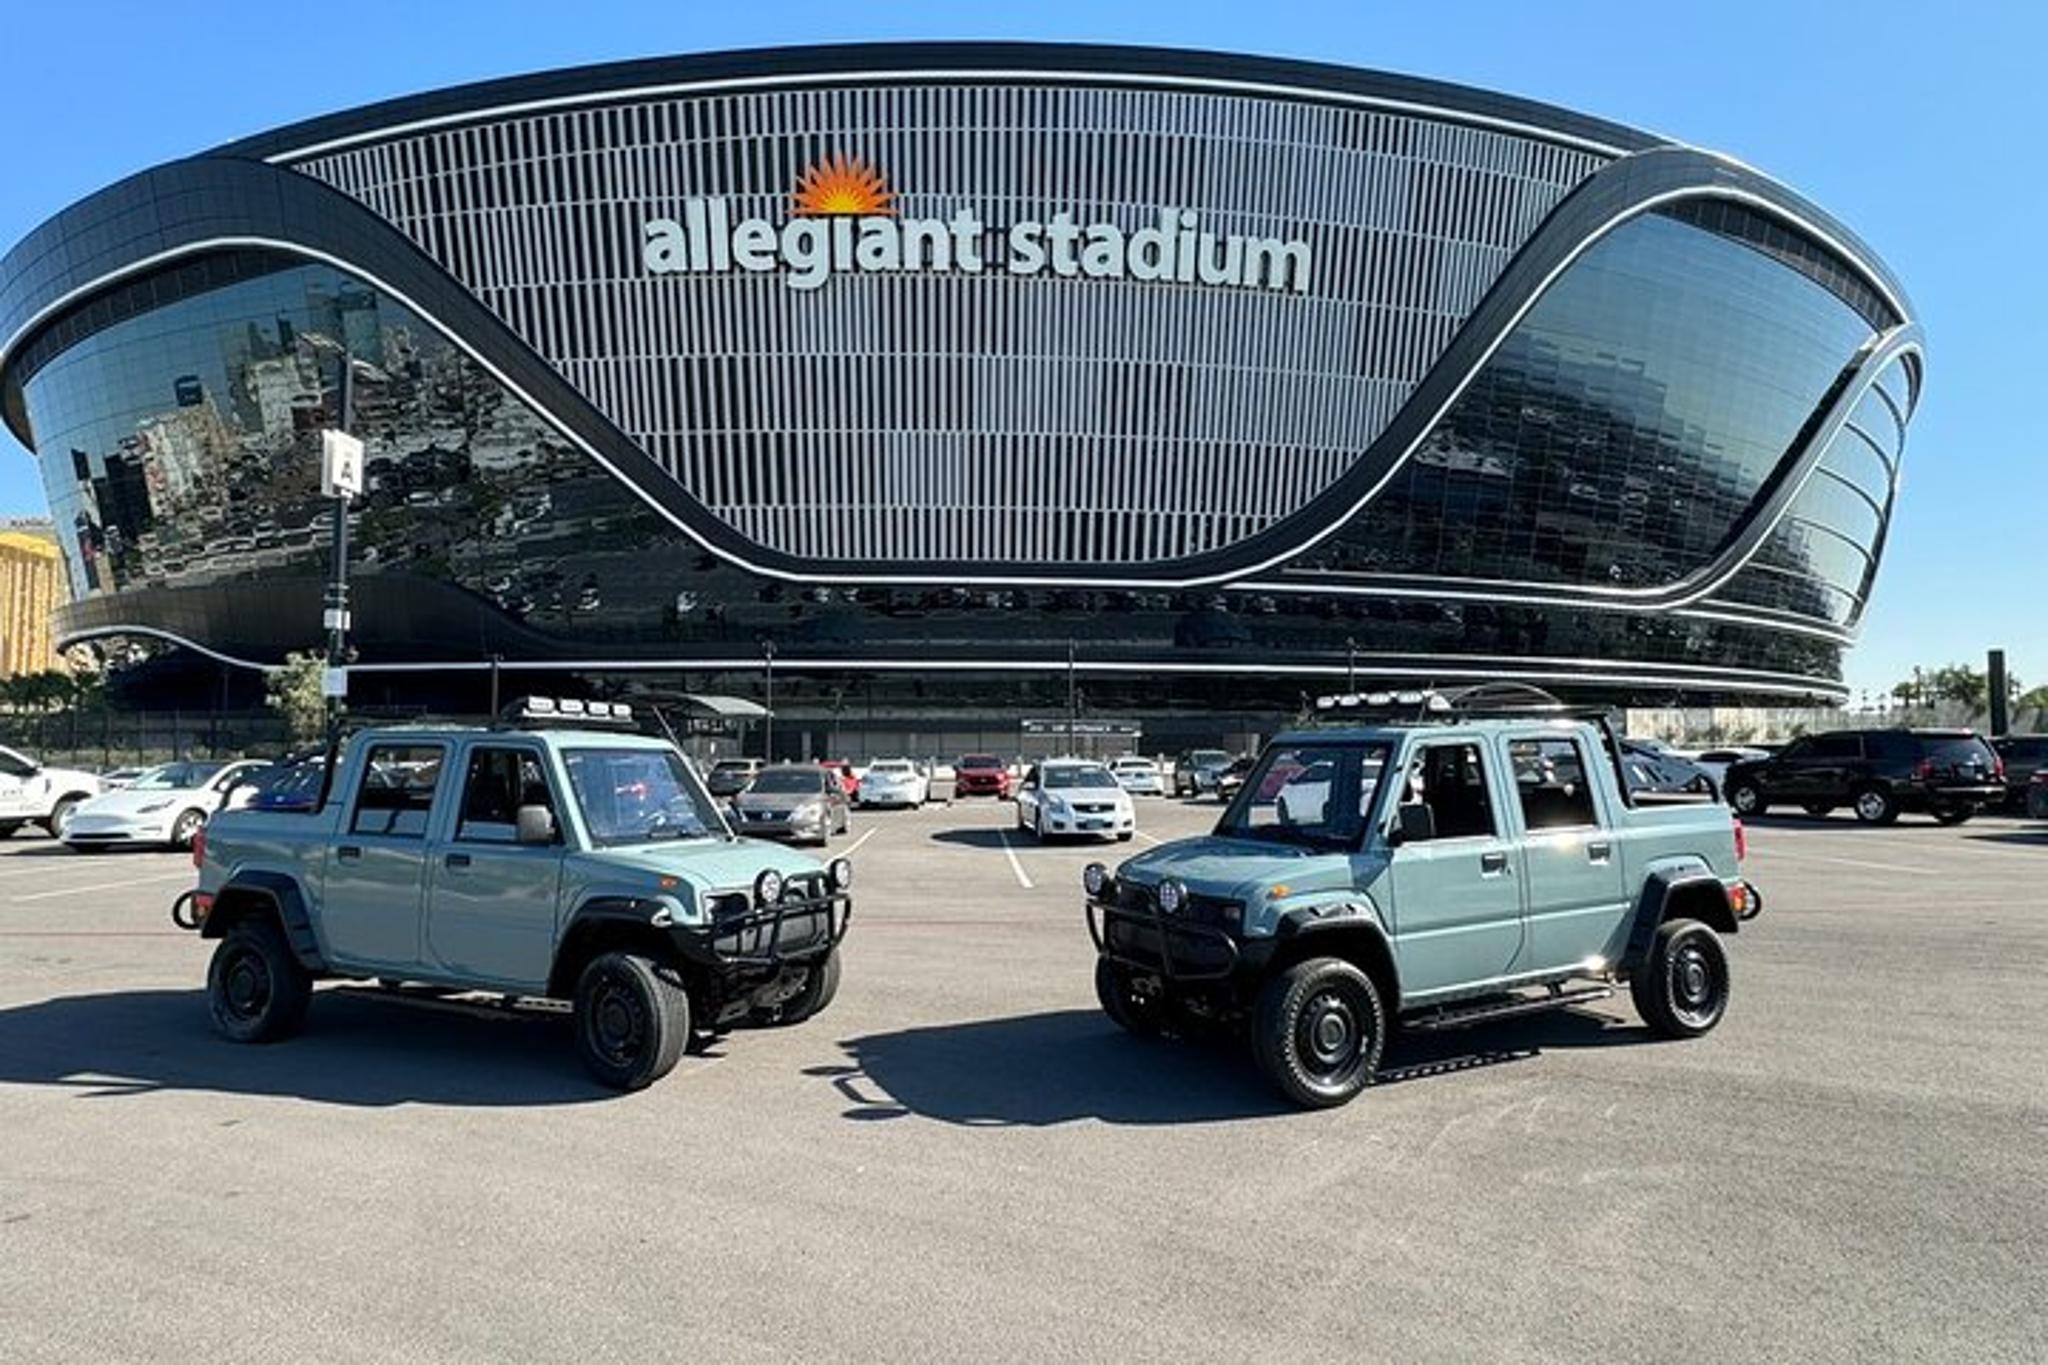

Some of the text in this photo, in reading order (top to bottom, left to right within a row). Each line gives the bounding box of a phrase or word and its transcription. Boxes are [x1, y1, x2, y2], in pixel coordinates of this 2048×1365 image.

[642, 198, 1313, 294] allegiant stadium
[340, 460, 354, 483] A
